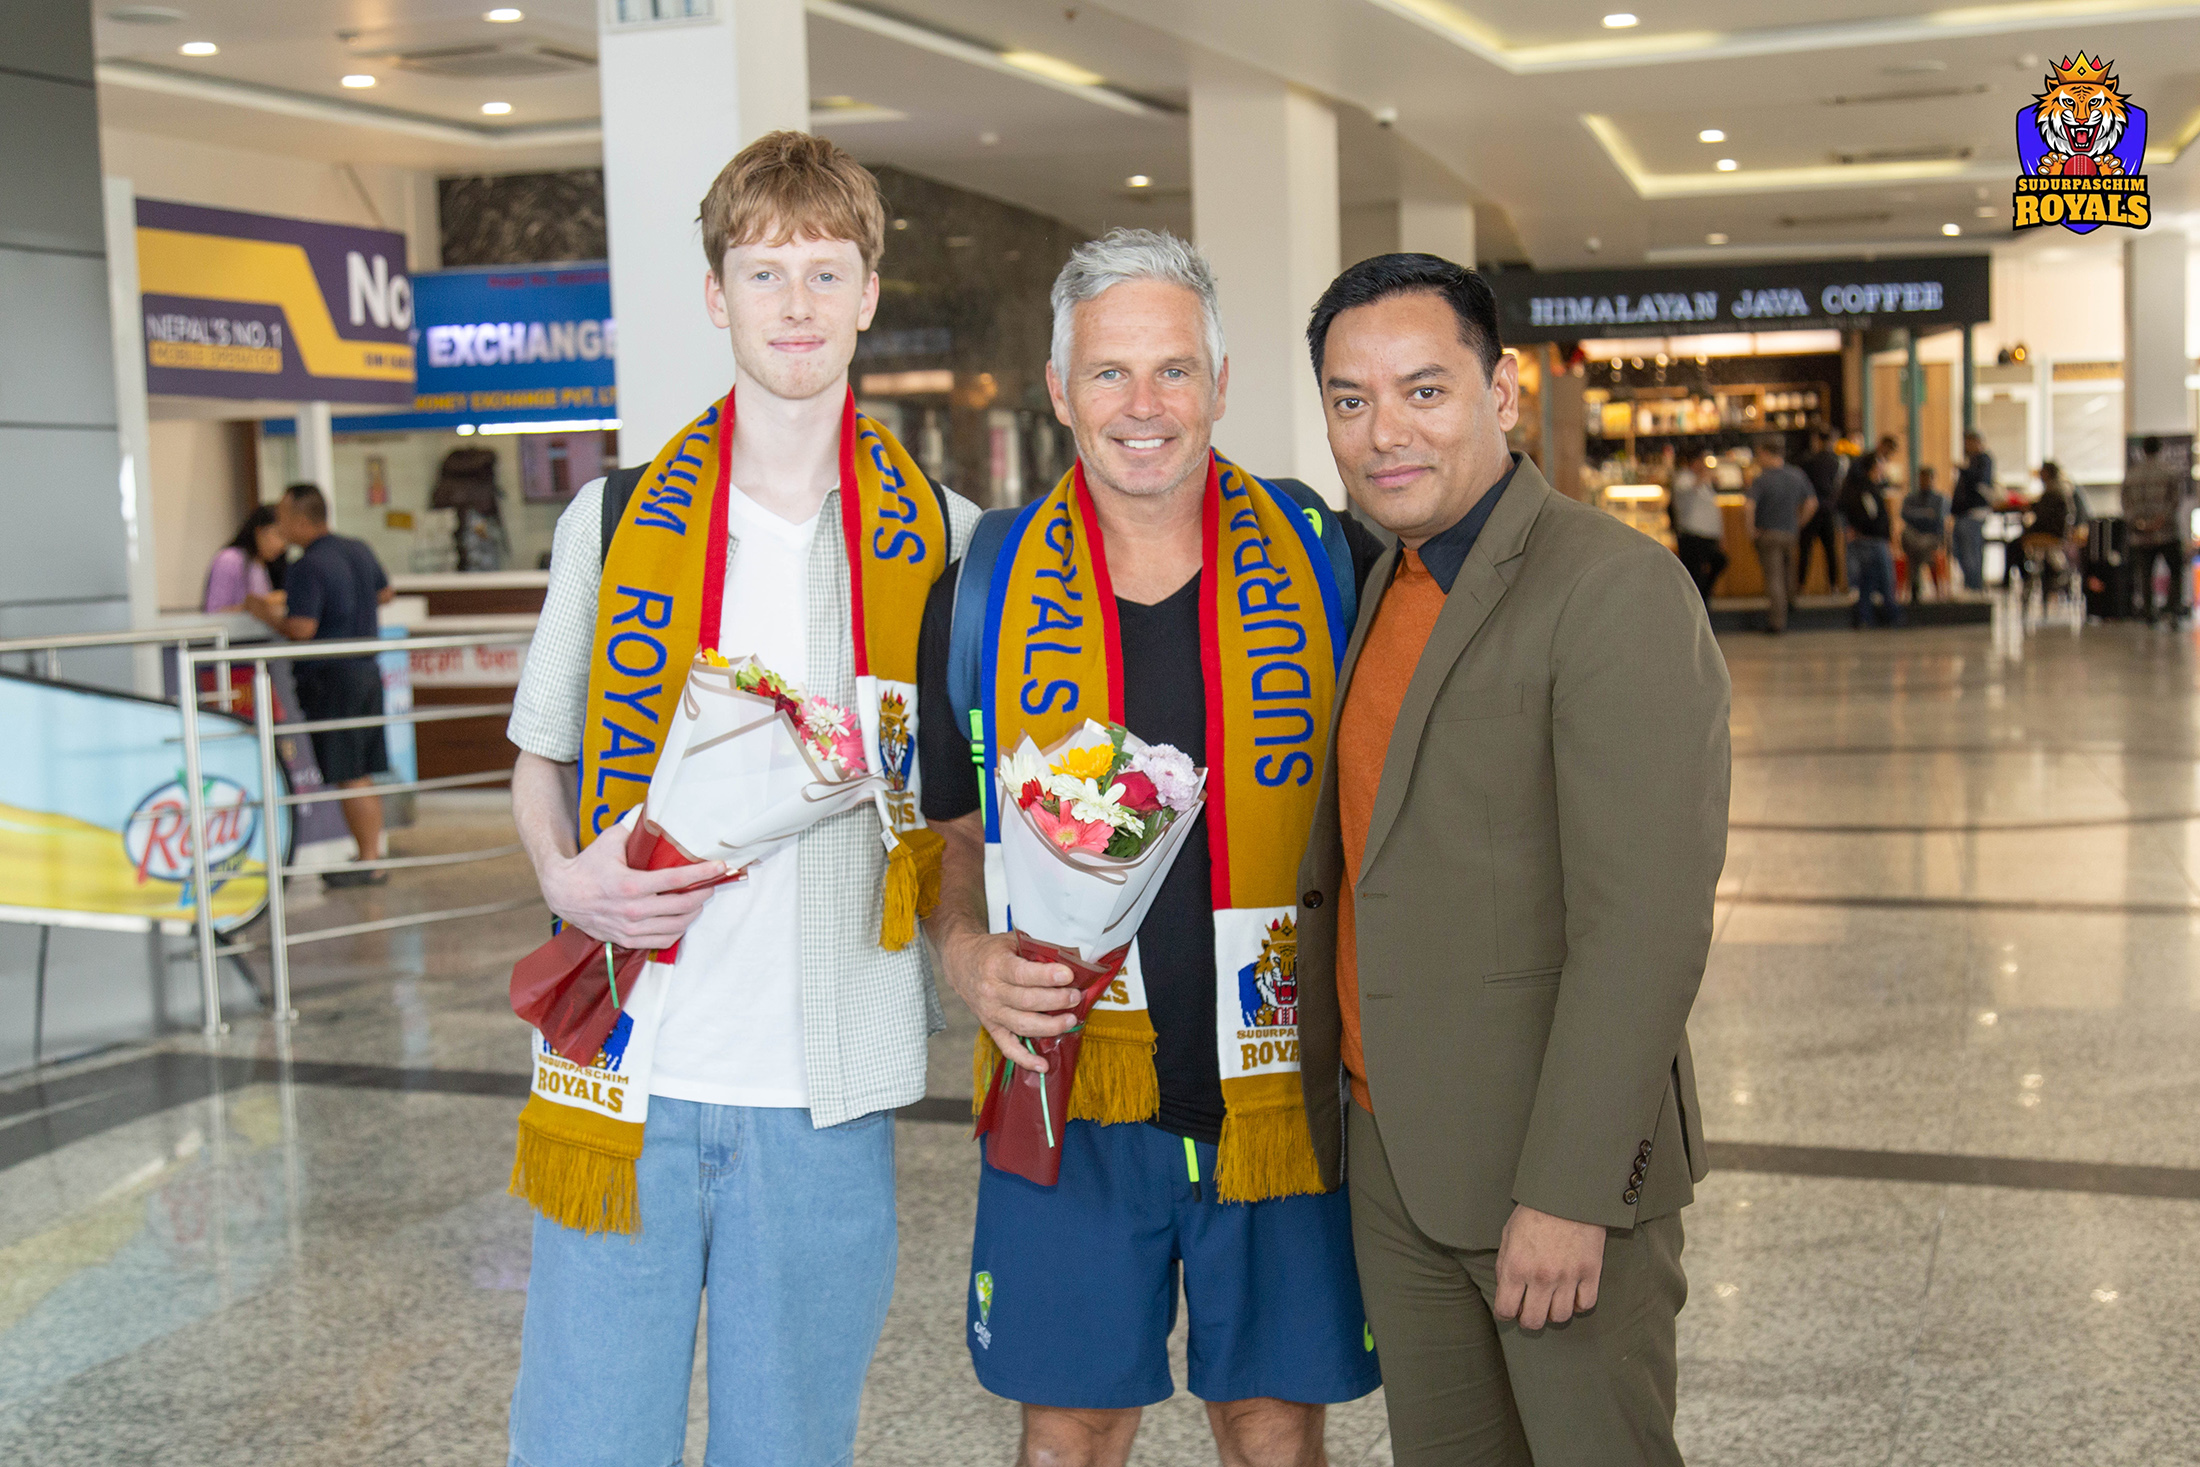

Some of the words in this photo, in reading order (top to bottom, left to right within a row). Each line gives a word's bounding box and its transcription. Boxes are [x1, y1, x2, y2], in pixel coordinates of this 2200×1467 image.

[1530, 291, 1718, 326] HIMALAYAN
[1731, 288, 1810, 320] JAVA
[1821, 281, 1943, 315] COFFEE
[146, 313, 232, 347] NEPAL'S
[426, 317, 618, 368] EXCHANGE
[1020, 500, 1084, 716] OYALS
[1236, 1027, 1300, 1040] SUDURPA
[537, 1066, 625, 1113] ROYALS
[538, 1053, 630, 1085] SUDURPASCHIM
